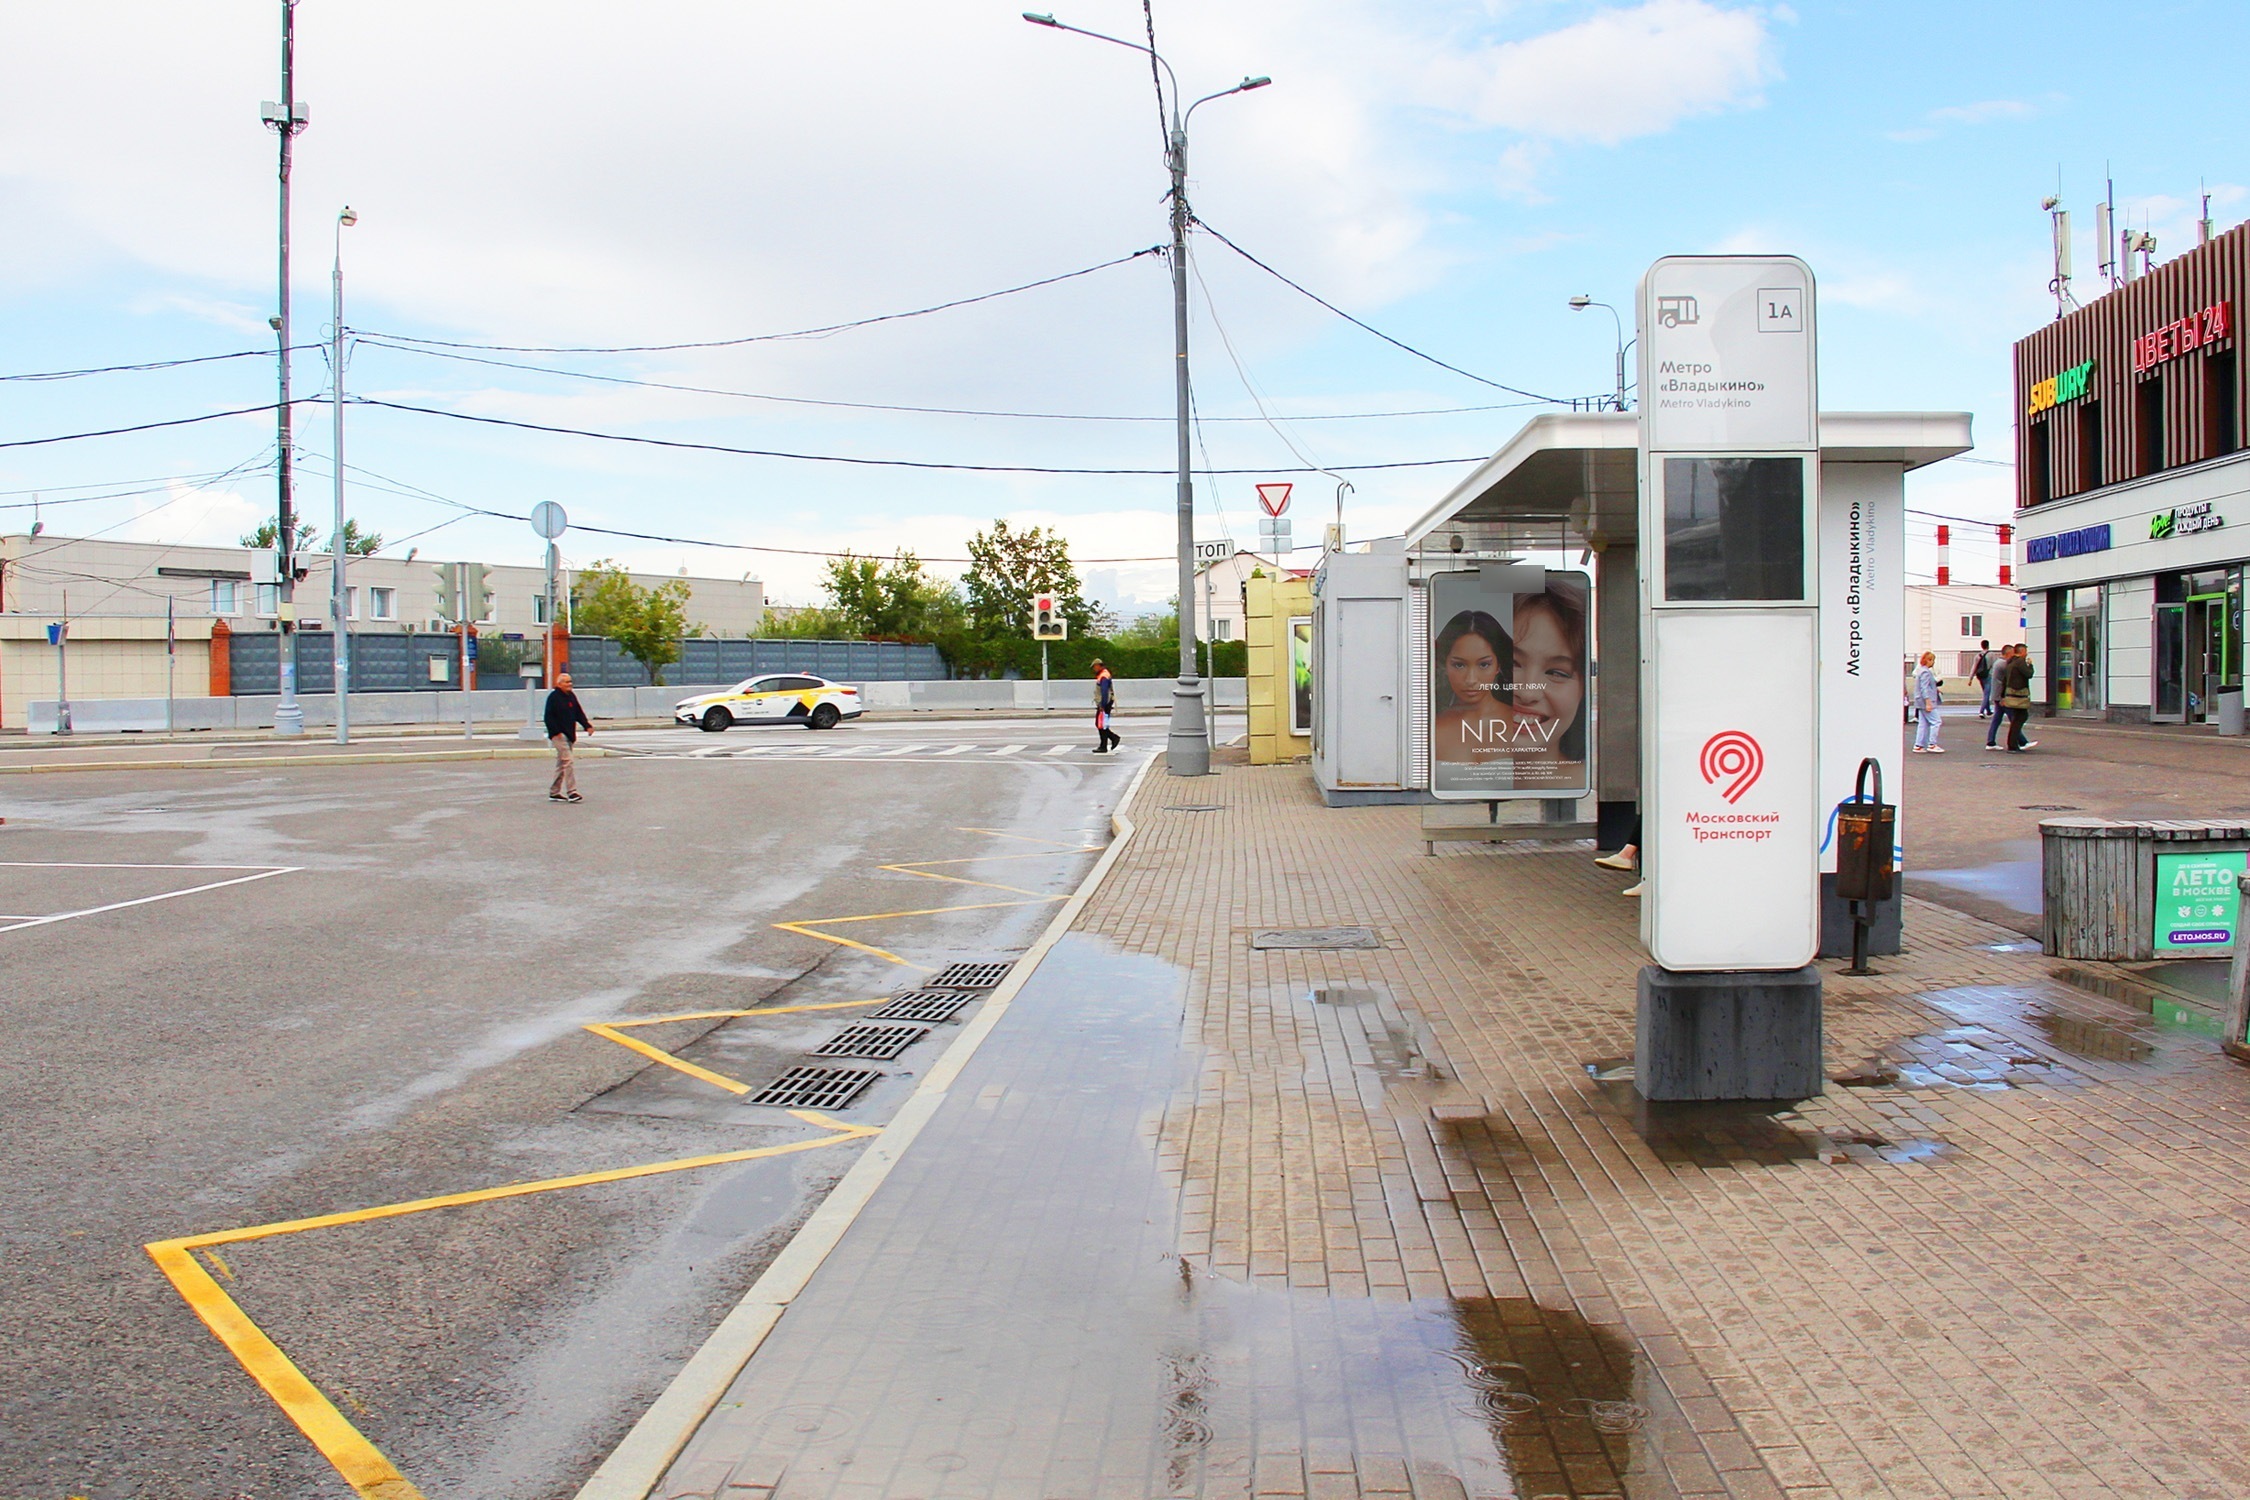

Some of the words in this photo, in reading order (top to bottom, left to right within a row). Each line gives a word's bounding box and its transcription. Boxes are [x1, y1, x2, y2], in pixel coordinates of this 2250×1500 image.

[2133, 313, 2201, 374] ЦВЕТЫ
[2202, 301, 2231, 346] 24
[1659, 361, 1712, 375] Метро
[1660, 378, 1765, 392] «Владыкино»
[2028, 358, 2095, 417] SUBWAY
[1659, 399, 1694, 408] Metro
[1696, 398, 1751, 410] Vladykino
[2175, 503, 2211, 518] ПРОДУКТЫ
[1866, 501, 1876, 555] Vladykino
[2175, 516, 2202, 533] КАЖДЫЙ
[2202, 515, 2223, 531] ДЕНЬ
[1196, 543, 1226, 558] ТОП
[1847, 501, 1861, 615] «Владыкино»
[1866, 557, 1875, 591] Metro
[1847, 620, 1862, 676] Метро
[1478, 683, 1501, 691] ЛЕТО.
[1503, 683, 1525, 691] ЦВЕТ.
[1461, 718, 1560, 743] NRAV
[1685, 811, 1780, 824] Московский
[1692, 827, 1772, 843] Транспорт
[2173, 868, 2233, 886] ЛЕТО
[2173, 888, 2180, 896] В
[2183, 887, 2231, 896] МОСКВЕ
[2173, 933, 2226, 941] LETO.MOS.RU
